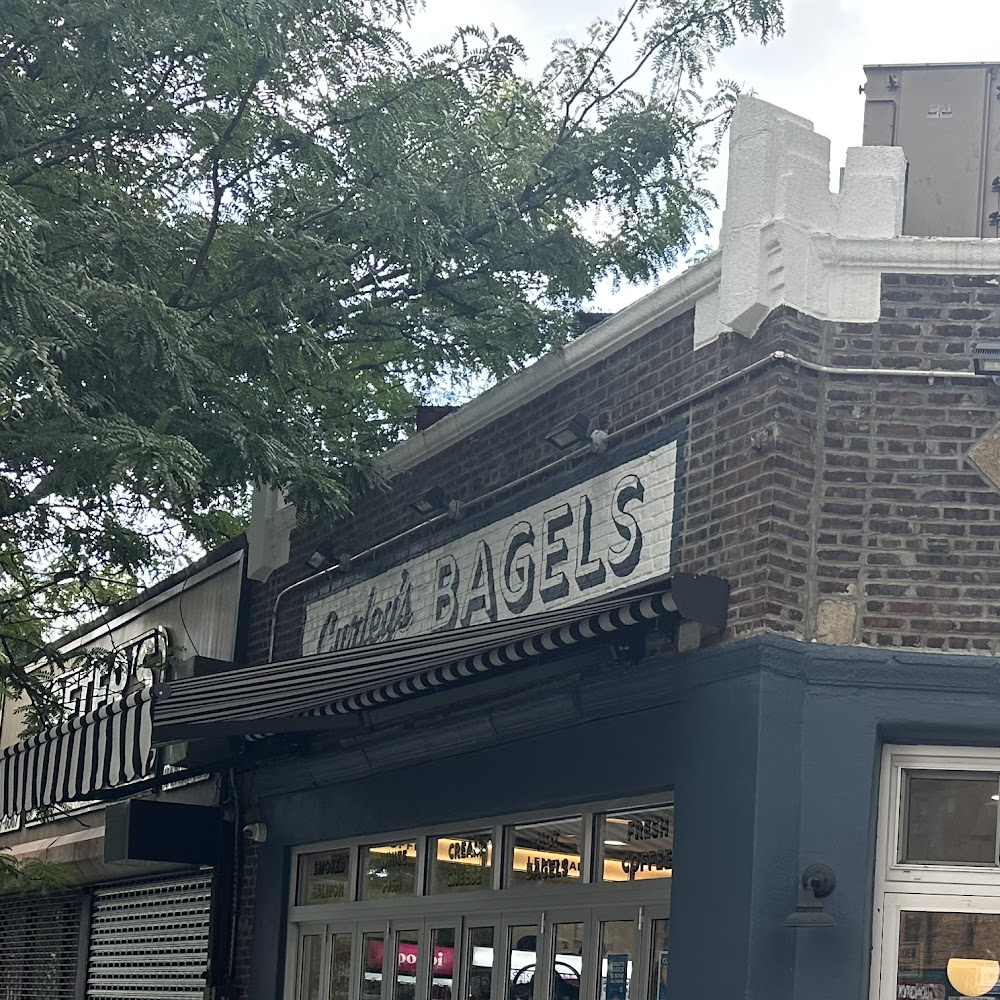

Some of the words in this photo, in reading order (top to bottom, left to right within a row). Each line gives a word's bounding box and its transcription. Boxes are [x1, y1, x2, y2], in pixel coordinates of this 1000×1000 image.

[433, 474, 645, 631] BAGELS
[627, 817, 669, 841] FRESH
[621, 849, 673, 873] COFFEE
